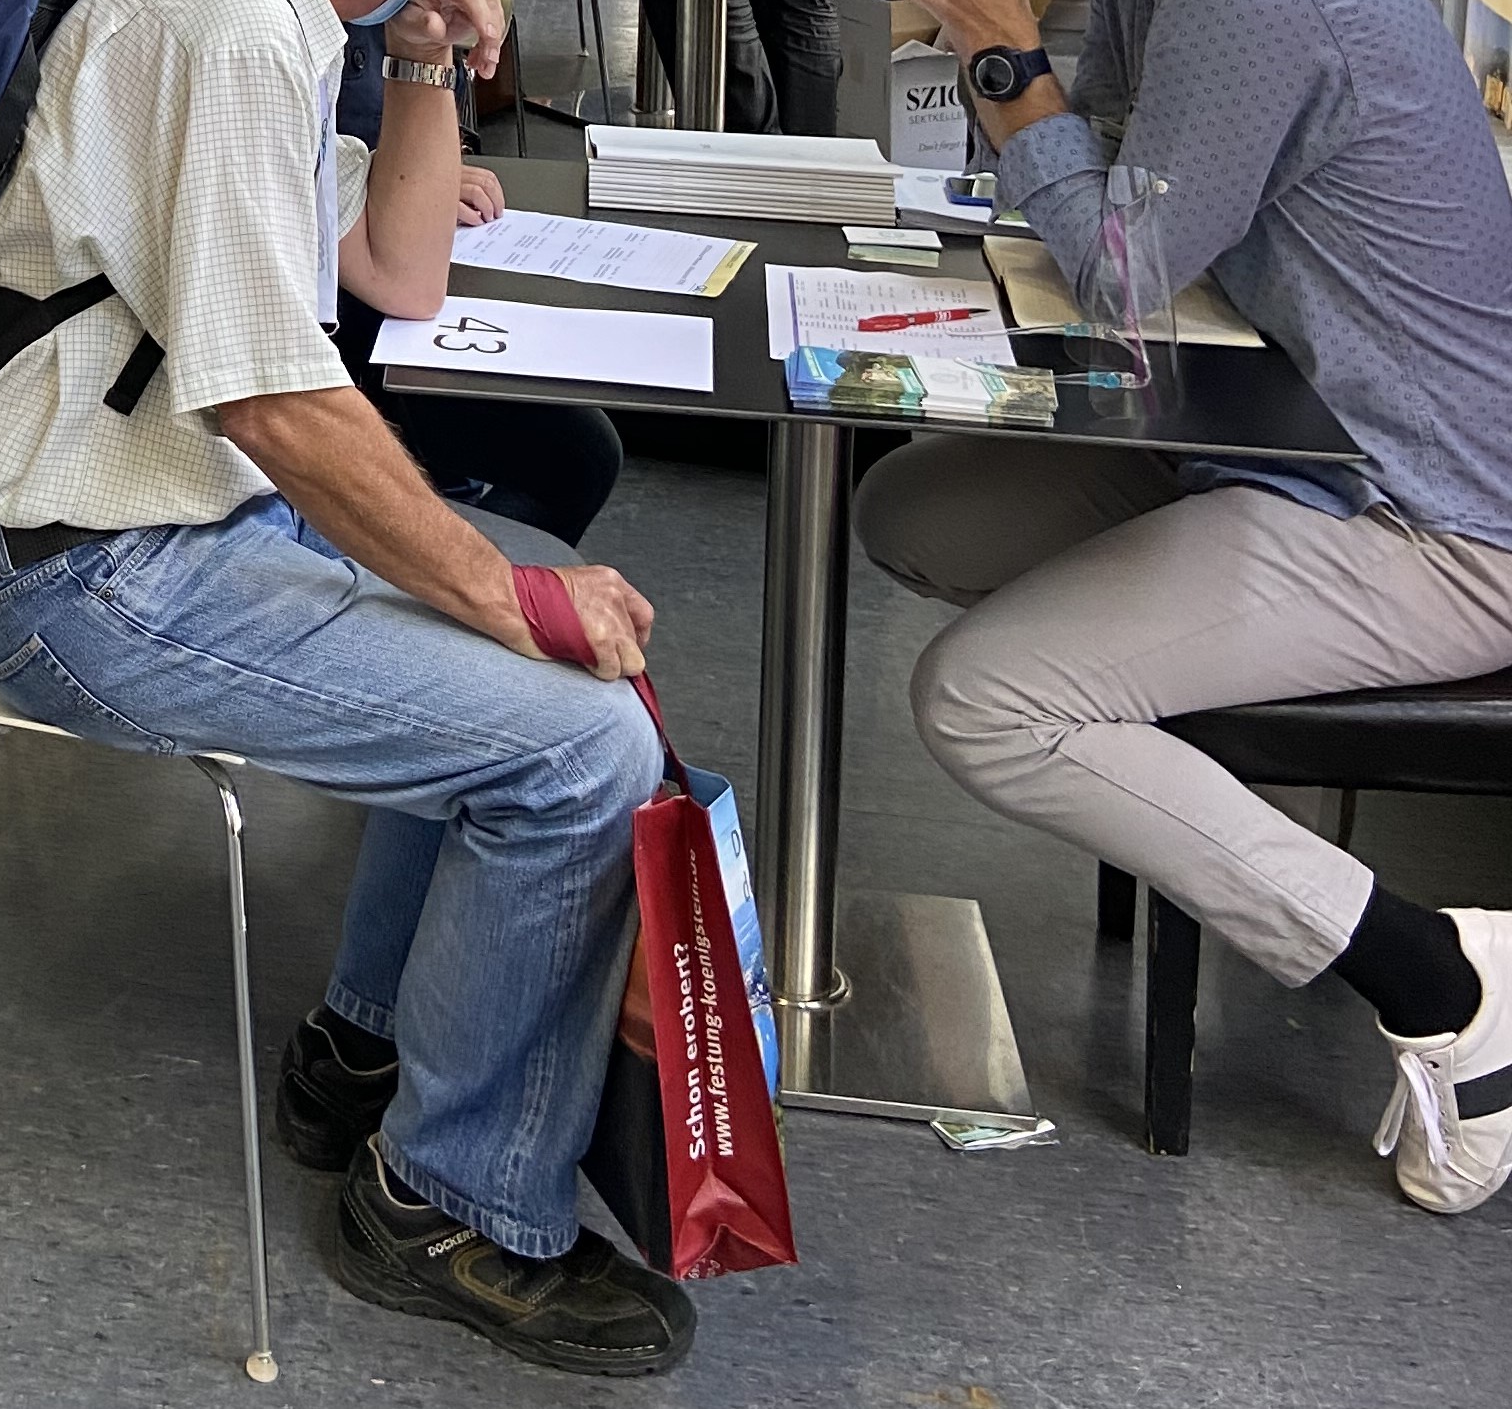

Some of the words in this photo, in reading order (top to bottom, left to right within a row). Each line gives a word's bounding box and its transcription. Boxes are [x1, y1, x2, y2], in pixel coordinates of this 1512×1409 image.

[433, 316, 510, 354] 43
[673, 942, 699, 1063] erobert?
[685, 1067, 706, 1161] Schon
[427, 1229, 478, 1257] DOCKERS
